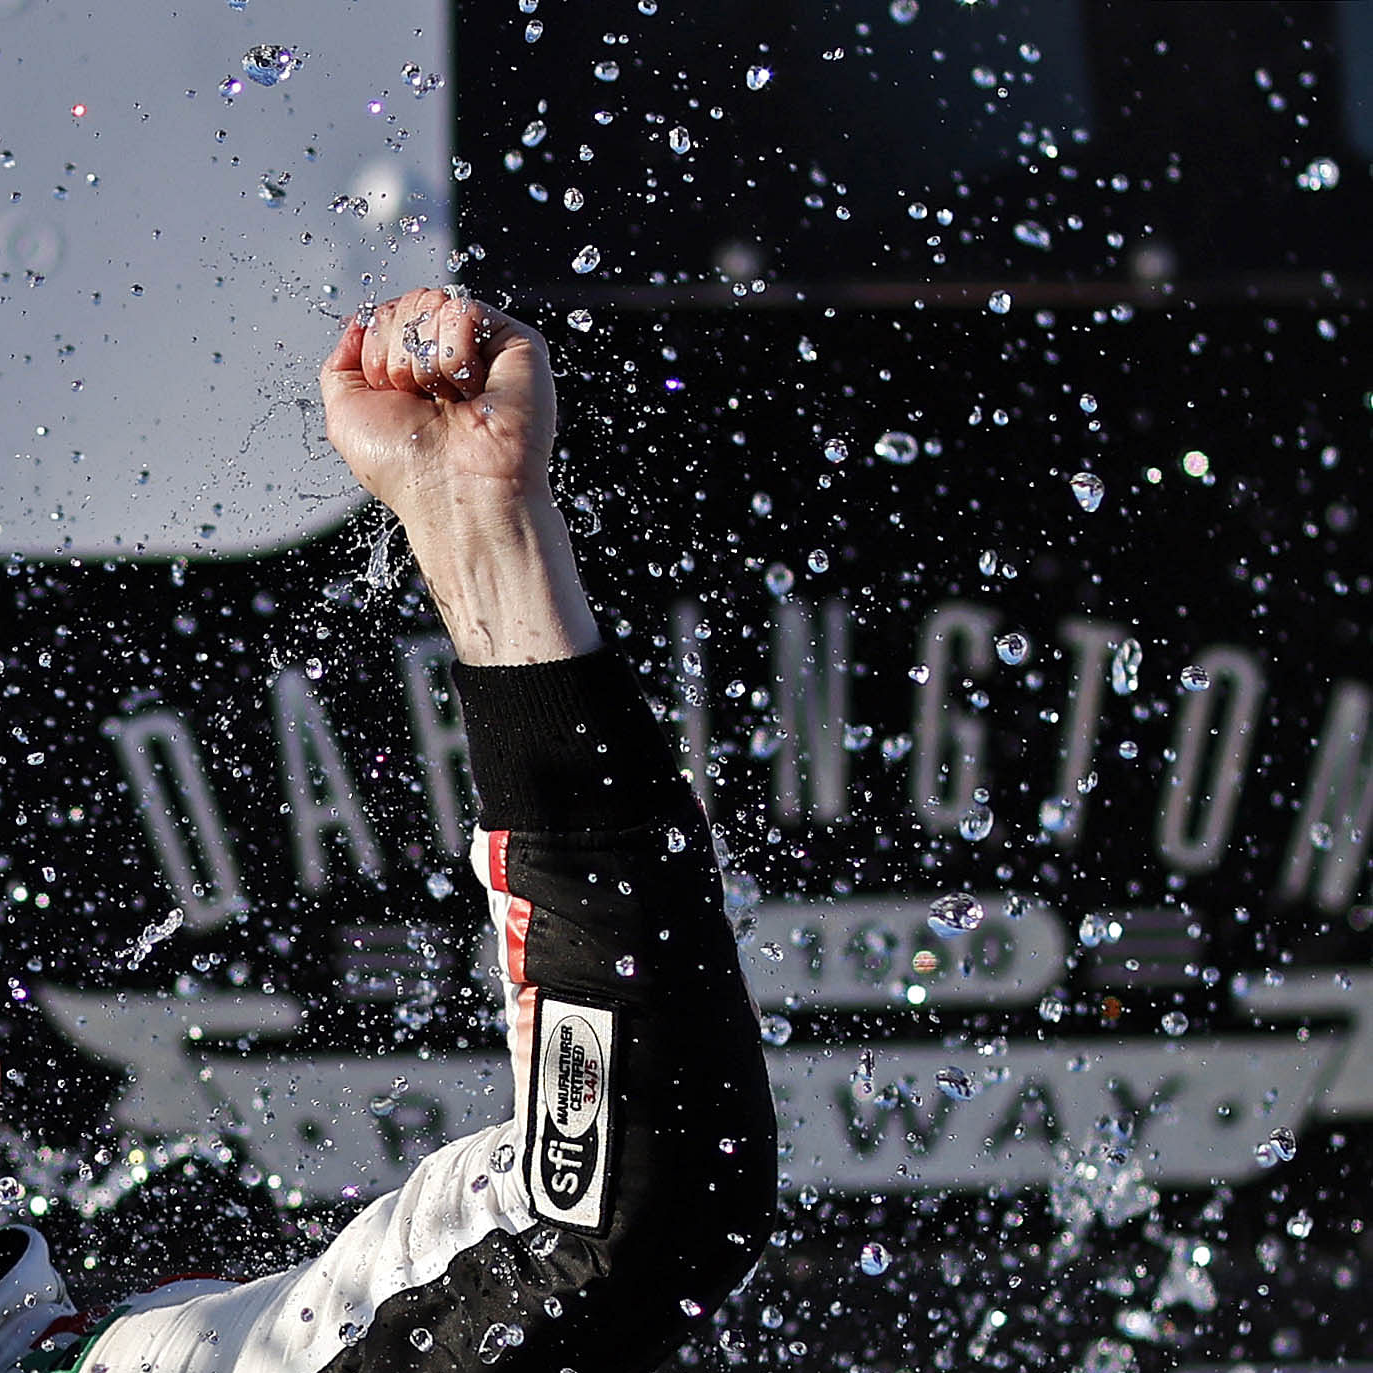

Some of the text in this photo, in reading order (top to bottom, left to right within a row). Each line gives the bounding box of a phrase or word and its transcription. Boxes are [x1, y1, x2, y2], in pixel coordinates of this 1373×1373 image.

[556, 1024, 574, 1126] MANUFACTURER
[570, 1044, 586, 1112] CERTIFIED
[547, 1138, 585, 1195] sfi
